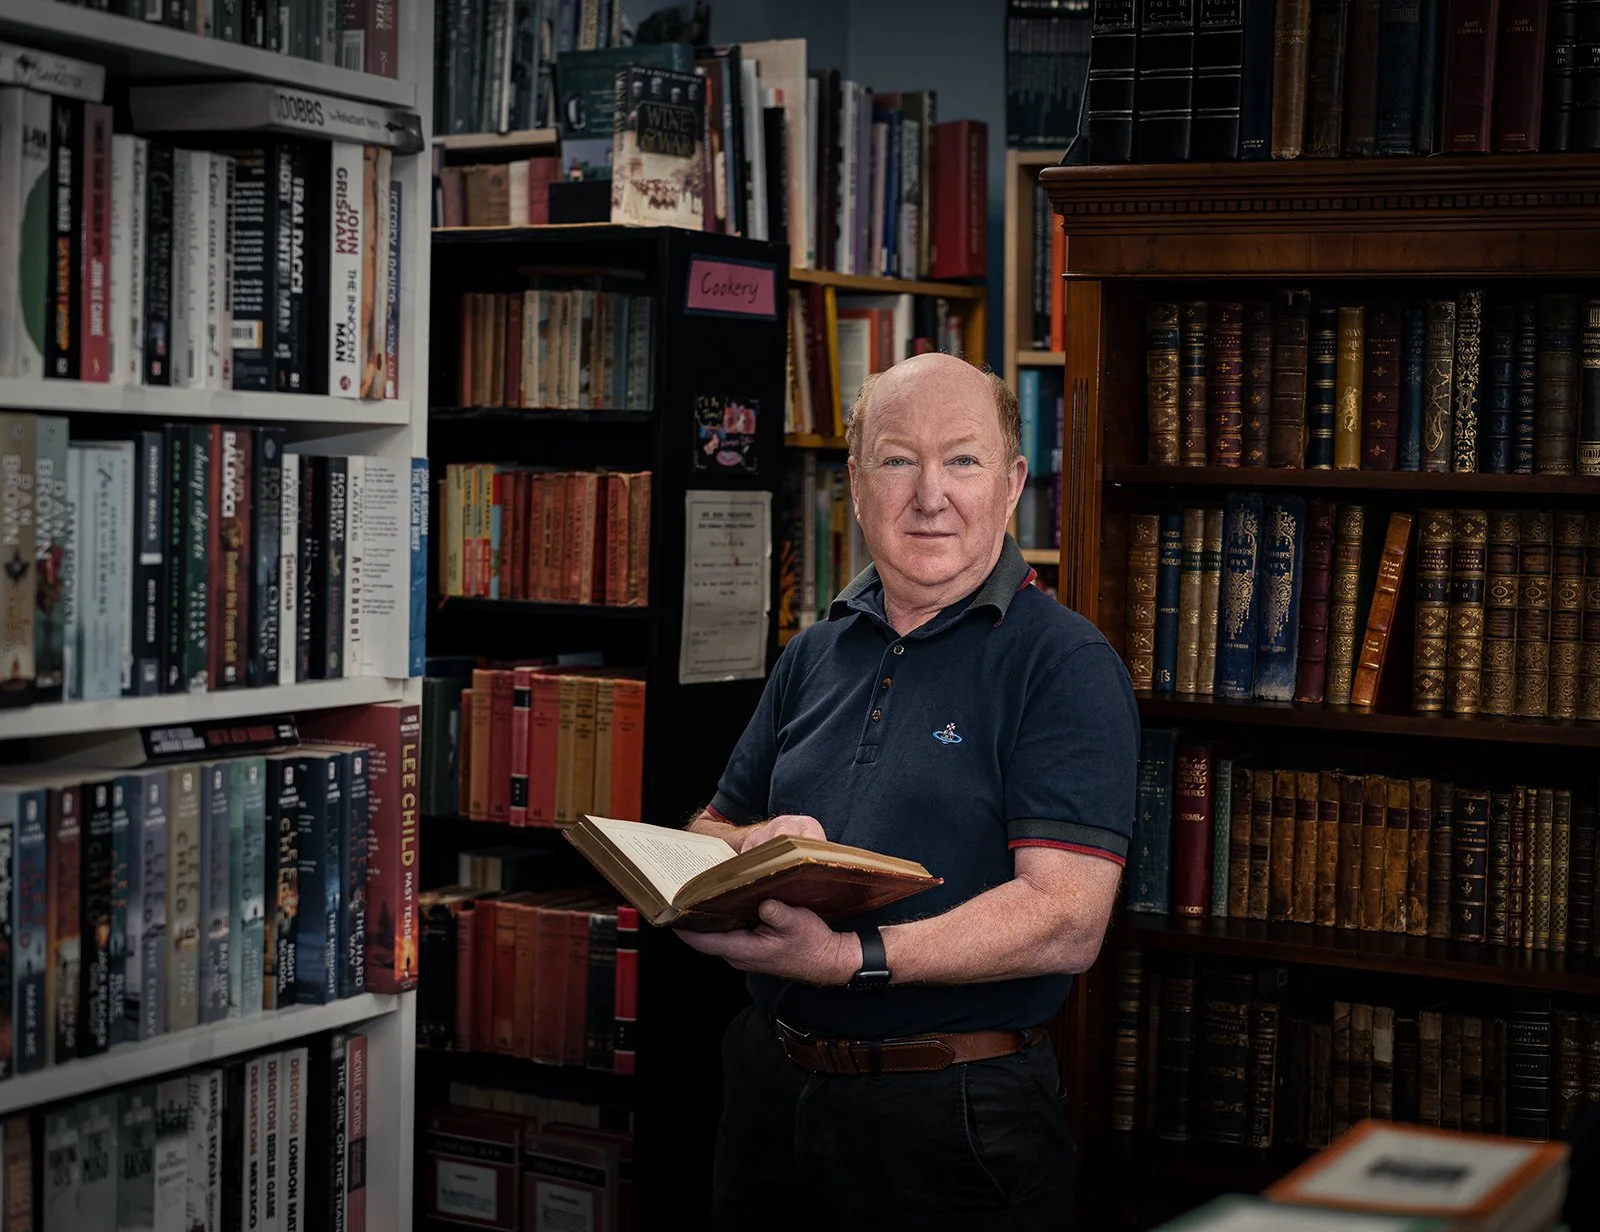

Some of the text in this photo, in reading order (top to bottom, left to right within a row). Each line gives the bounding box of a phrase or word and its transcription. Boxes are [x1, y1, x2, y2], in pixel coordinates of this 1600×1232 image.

[278, 95, 325, 126] DOBBS
[647, 104, 693, 132] WINE
[657, 130, 693, 158] WAR
[290, 185, 304, 295] BALDACCI
[335, 166, 348, 254] GRISHAM
[346, 205, 359, 256] JOHN
[278, 288, 291, 334] MAN
[346, 269, 357, 366] THE INNOCENT
[701, 272, 760, 304] Cookery
[335, 322, 346, 362] MAN
[3, 454, 20, 546] BROWN
[19, 474, 32, 526] DAN
[188, 442, 209, 560] sharp objects
[221, 431, 237, 518] BALDACCI
[328, 472, 338, 543] HARRIS
[335, 472, 345, 542] ROBERT
[411, 486, 421, 525] PELICAN
[412, 466, 421, 484] THE
[36, 458, 54, 562] BROWN
[53, 480, 66, 538] DAN
[352, 475, 360, 542] HARRIS
[225, 612, 237, 639] From
[351, 555, 362, 643] Archangel
[400, 743, 416, 867] LEE CHILD
[143, 840, 155, 923] CHILD
[175, 831, 188, 914] CHILD
[188, 843, 199, 894] LEE
[328, 912, 337, 938] THE
[403, 871, 412, 943] PAST TENSE
[219, 942, 229, 1009] BAD LUCK
[278, 938, 288, 993] SCHOOL
[287, 943, 296, 984] NIGHT
[348, 934, 356, 968] WAY
[354, 910, 365, 988] THE HARD
[24, 983, 37, 1057] MAKE ME
[147, 978, 158, 1038] ENEMY
[289, 1057, 300, 1134] DEIGHTON
[353, 1050, 362, 1087] MICHAEL
[265, 1060, 277, 1220] DEIGHTON BERLIN GAME
[352, 1090, 362, 1135] CRICHTON
[248, 1065, 259, 1229] DEIGHTON MEXICO
[287, 1137, 299, 1200] LONDON
[335, 1062, 346, 1232] THE GIRL ON THE TRAIN
